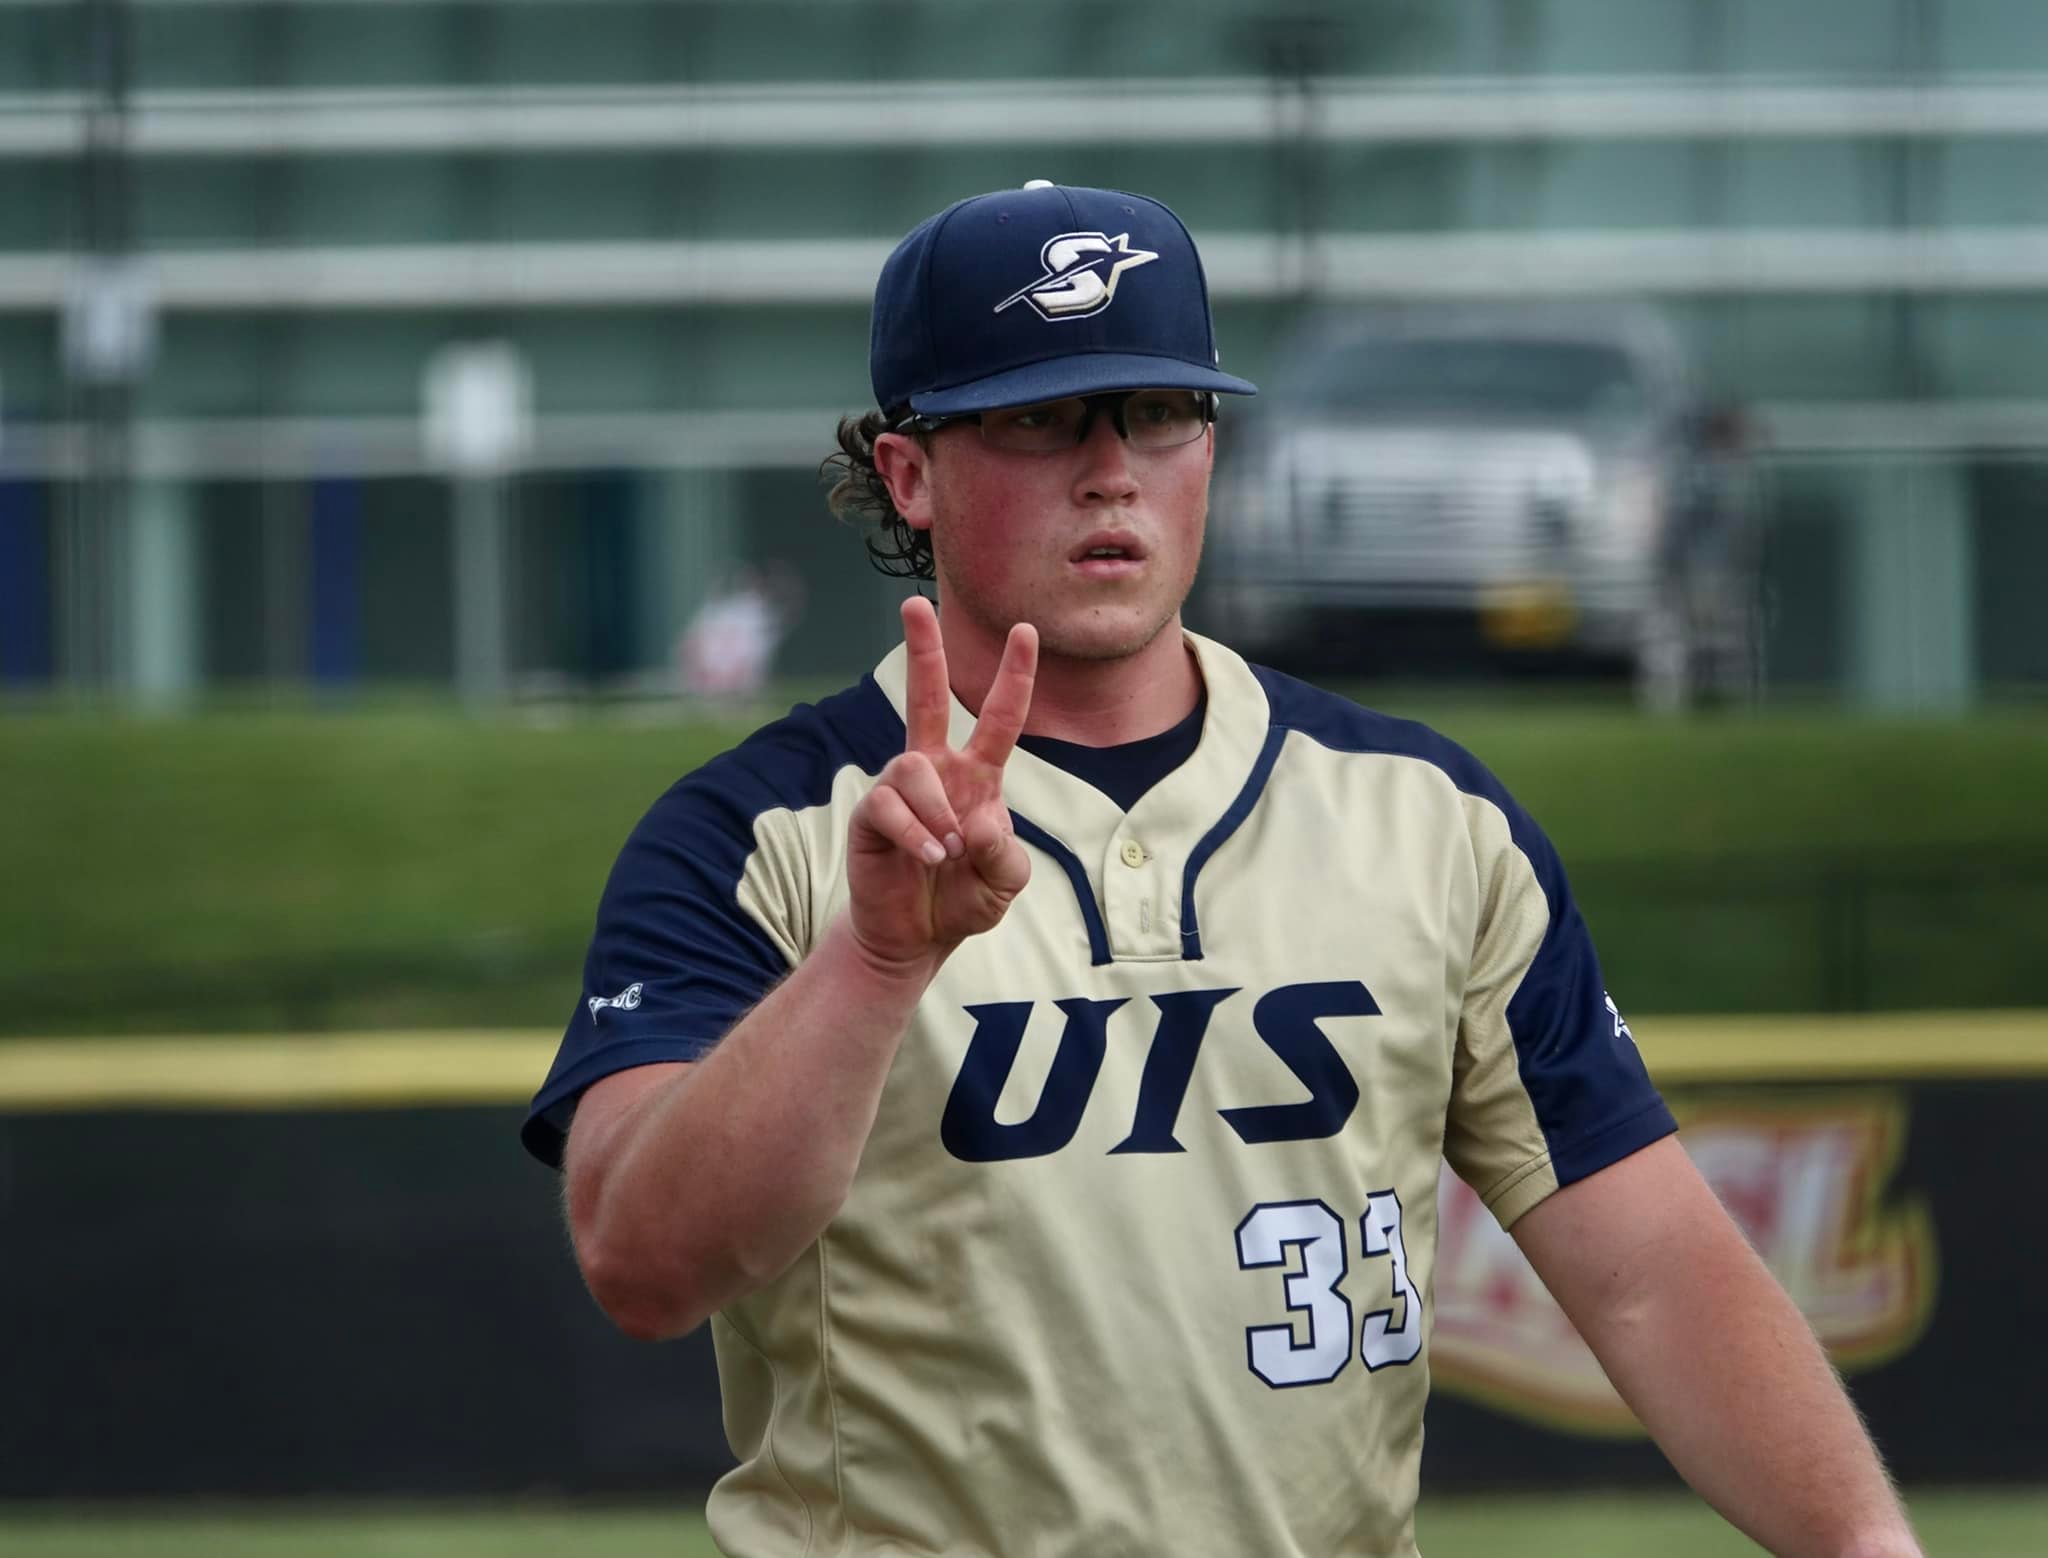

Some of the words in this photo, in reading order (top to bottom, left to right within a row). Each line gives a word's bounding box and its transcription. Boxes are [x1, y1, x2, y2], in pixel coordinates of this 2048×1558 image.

[1022, 232, 1114, 321] S
[941, 980, 1383, 1163] UIS
[1234, 1187, 1423, 1389] 33
